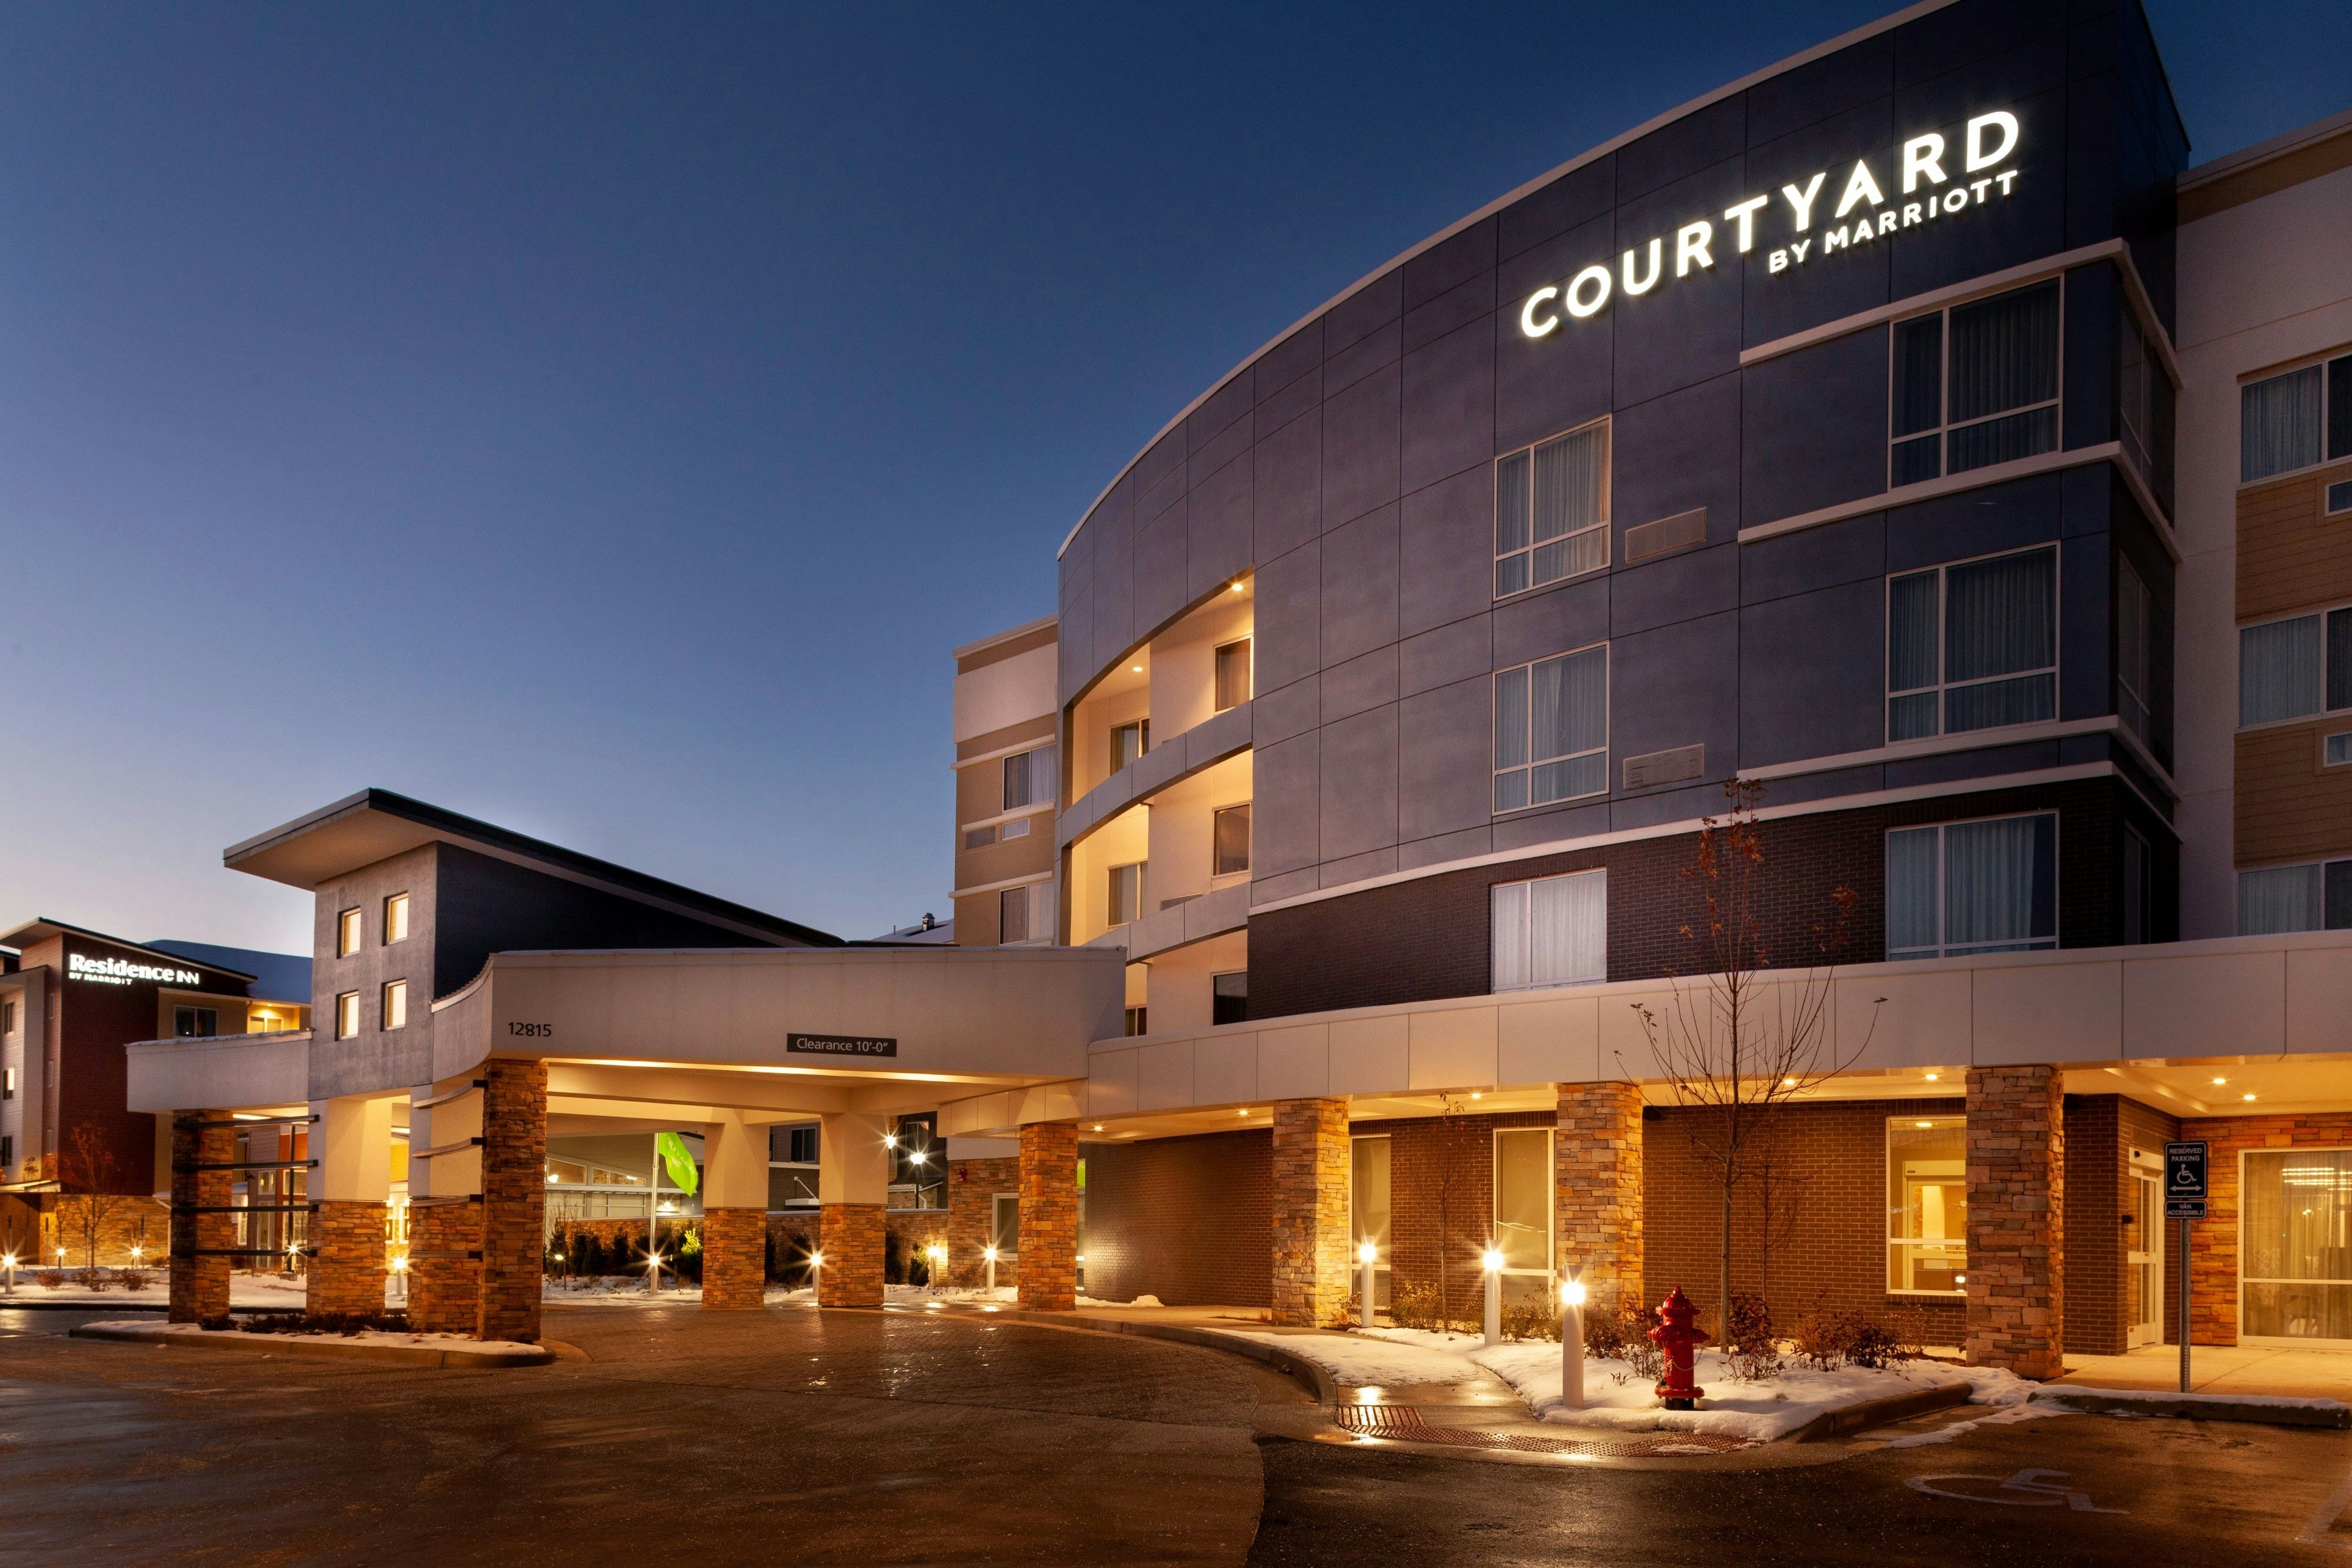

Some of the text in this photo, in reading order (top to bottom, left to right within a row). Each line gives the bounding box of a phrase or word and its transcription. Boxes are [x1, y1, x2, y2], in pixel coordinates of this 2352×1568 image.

[1521, 111, 2019, 337] COURTYARD
[1769, 170, 2017, 273] BY MARRIOTT
[69, 954, 175, 982] Residence
[508, 1022, 552, 1037] 12815
[797, 1038, 852, 1051] Clearance
